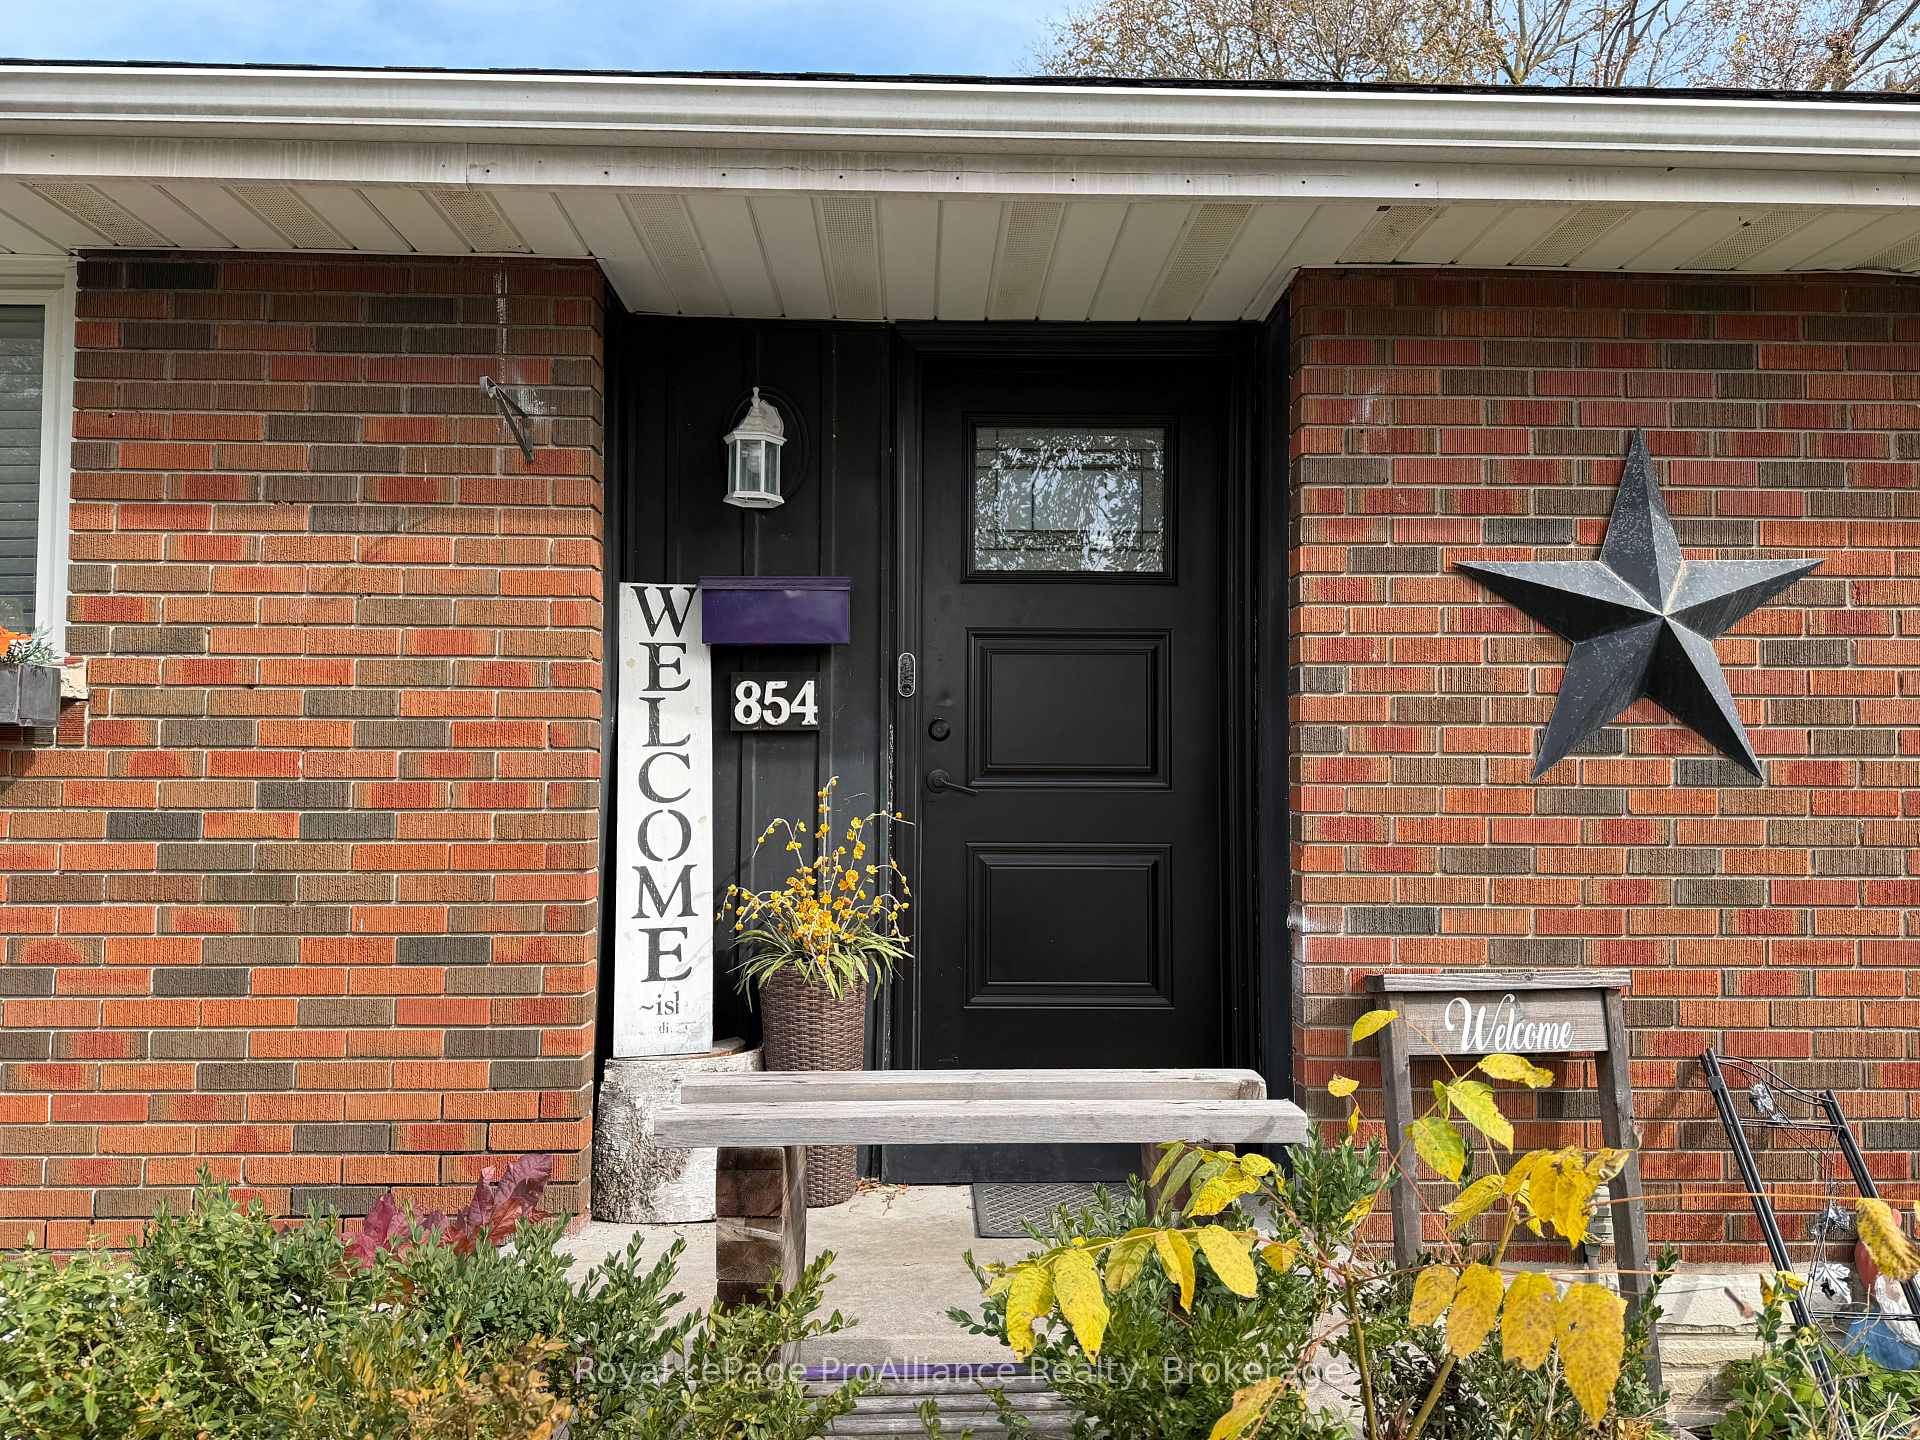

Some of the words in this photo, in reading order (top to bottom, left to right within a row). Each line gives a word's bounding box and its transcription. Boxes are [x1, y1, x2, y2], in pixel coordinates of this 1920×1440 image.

[734, 680, 818, 726] 854
[630, 585, 699, 983] WELCOME
[1444, 993, 1575, 1051] Welcome
